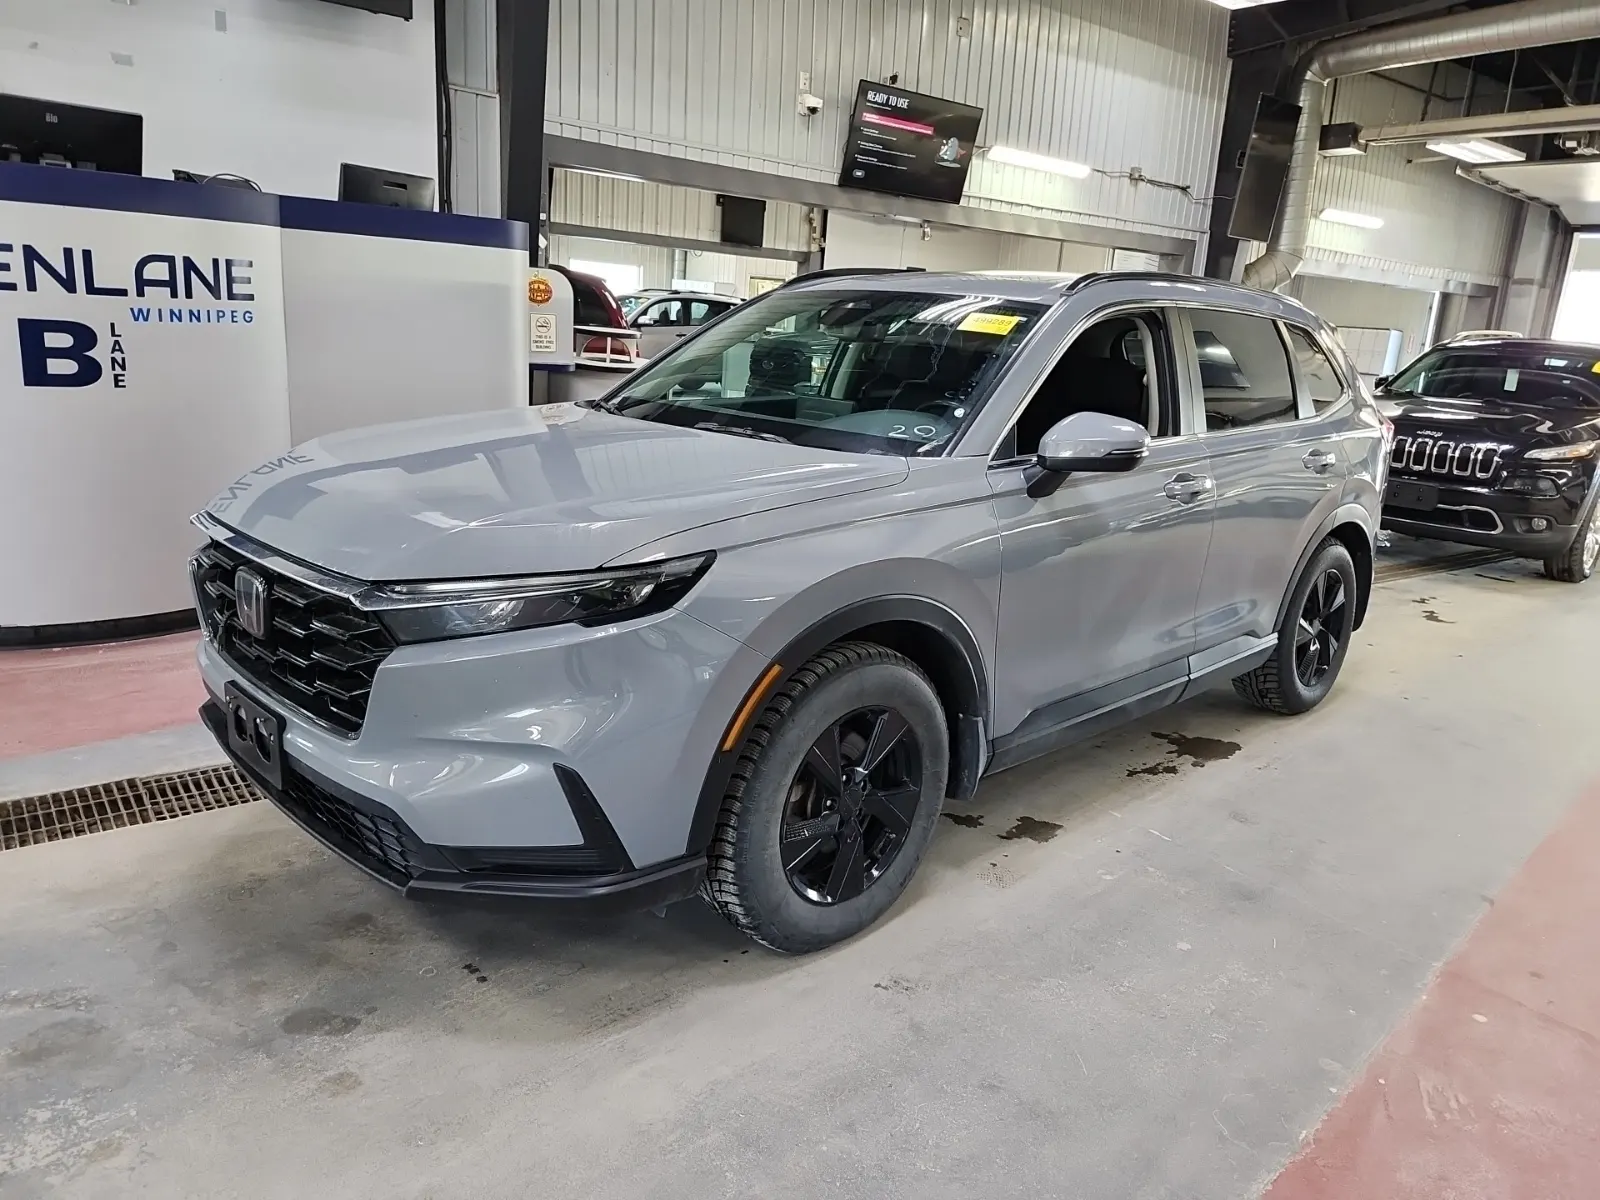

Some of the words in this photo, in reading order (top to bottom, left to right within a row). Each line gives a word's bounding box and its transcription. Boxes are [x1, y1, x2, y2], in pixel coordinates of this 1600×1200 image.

[867, 91, 888, 104] READY
[889, 95, 897, 106] TO
[897, 97, 910, 109] USE
[130, 307, 254, 324] WINNIPEG
[17, 317, 103, 388] B
[109, 322, 127, 389] LANE
[888, 425, 936, 438] 20
